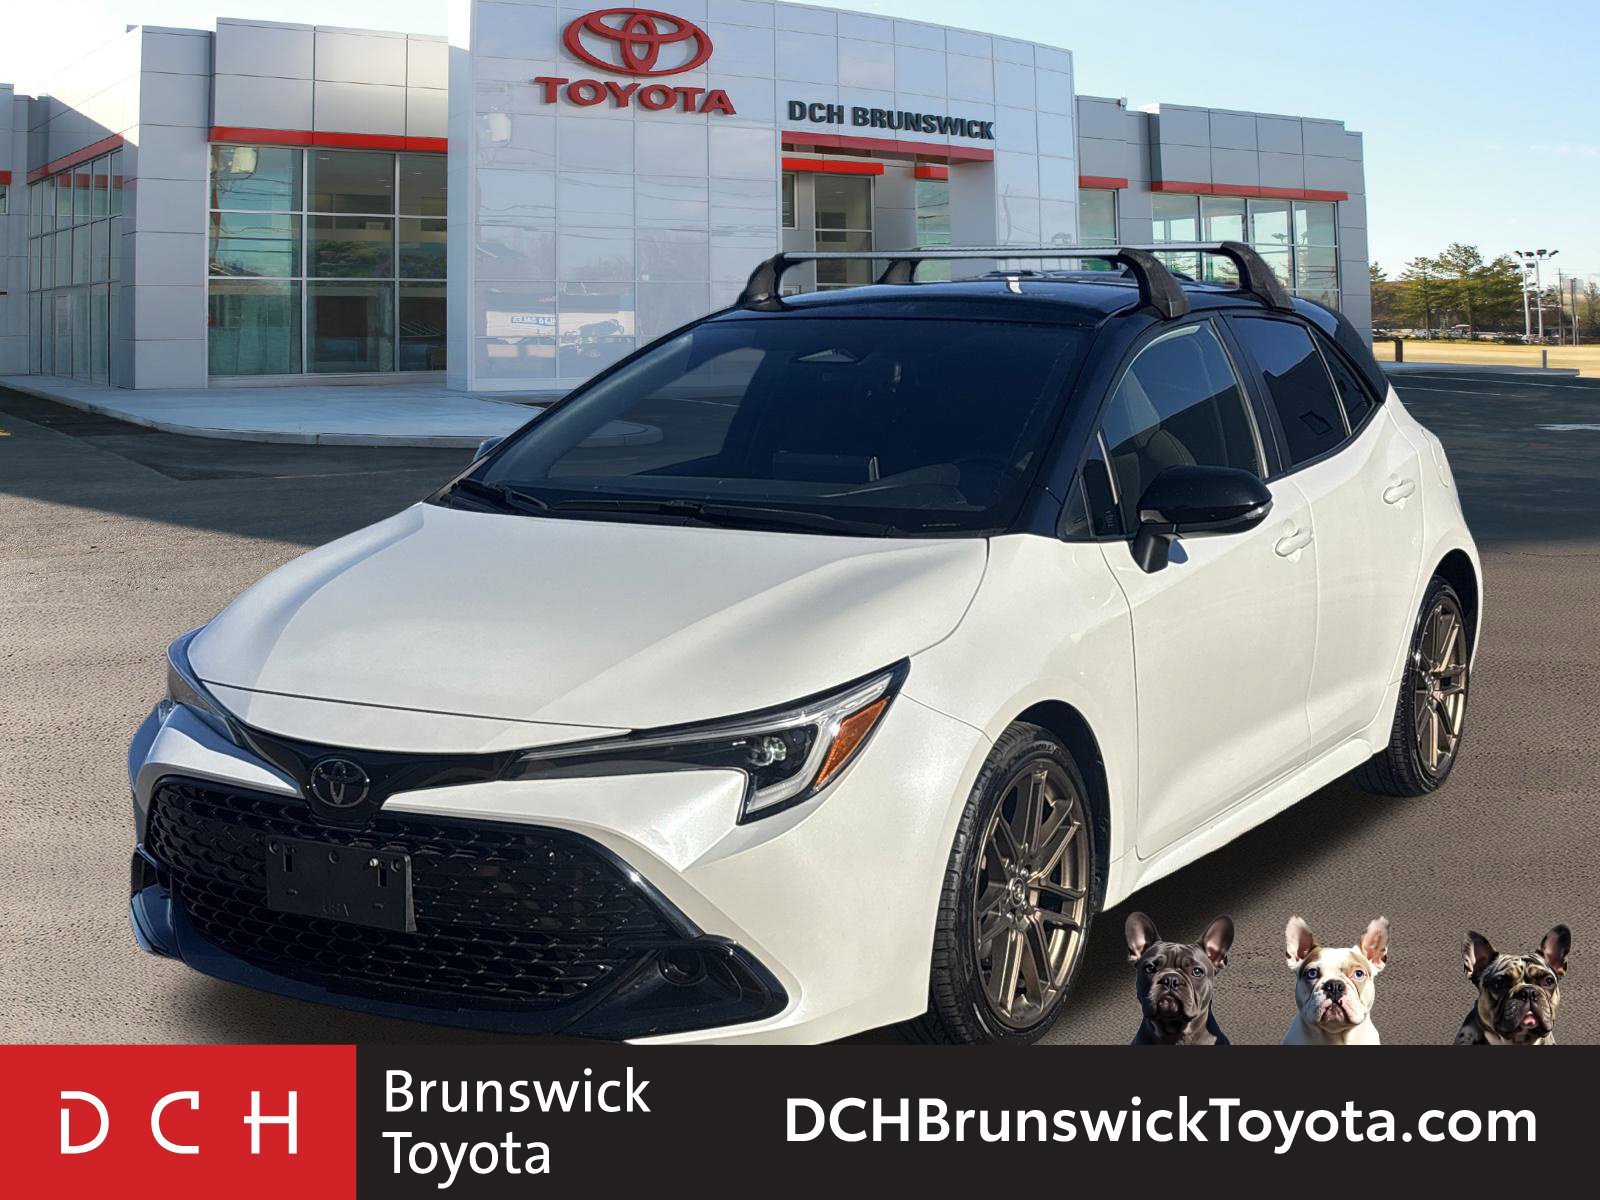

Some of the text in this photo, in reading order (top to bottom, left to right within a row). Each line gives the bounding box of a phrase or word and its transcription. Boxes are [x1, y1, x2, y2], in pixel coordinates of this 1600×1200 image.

[534, 76, 736, 115] TOYOTA
[788, 100, 994, 140] DCH BRUNSWICK
